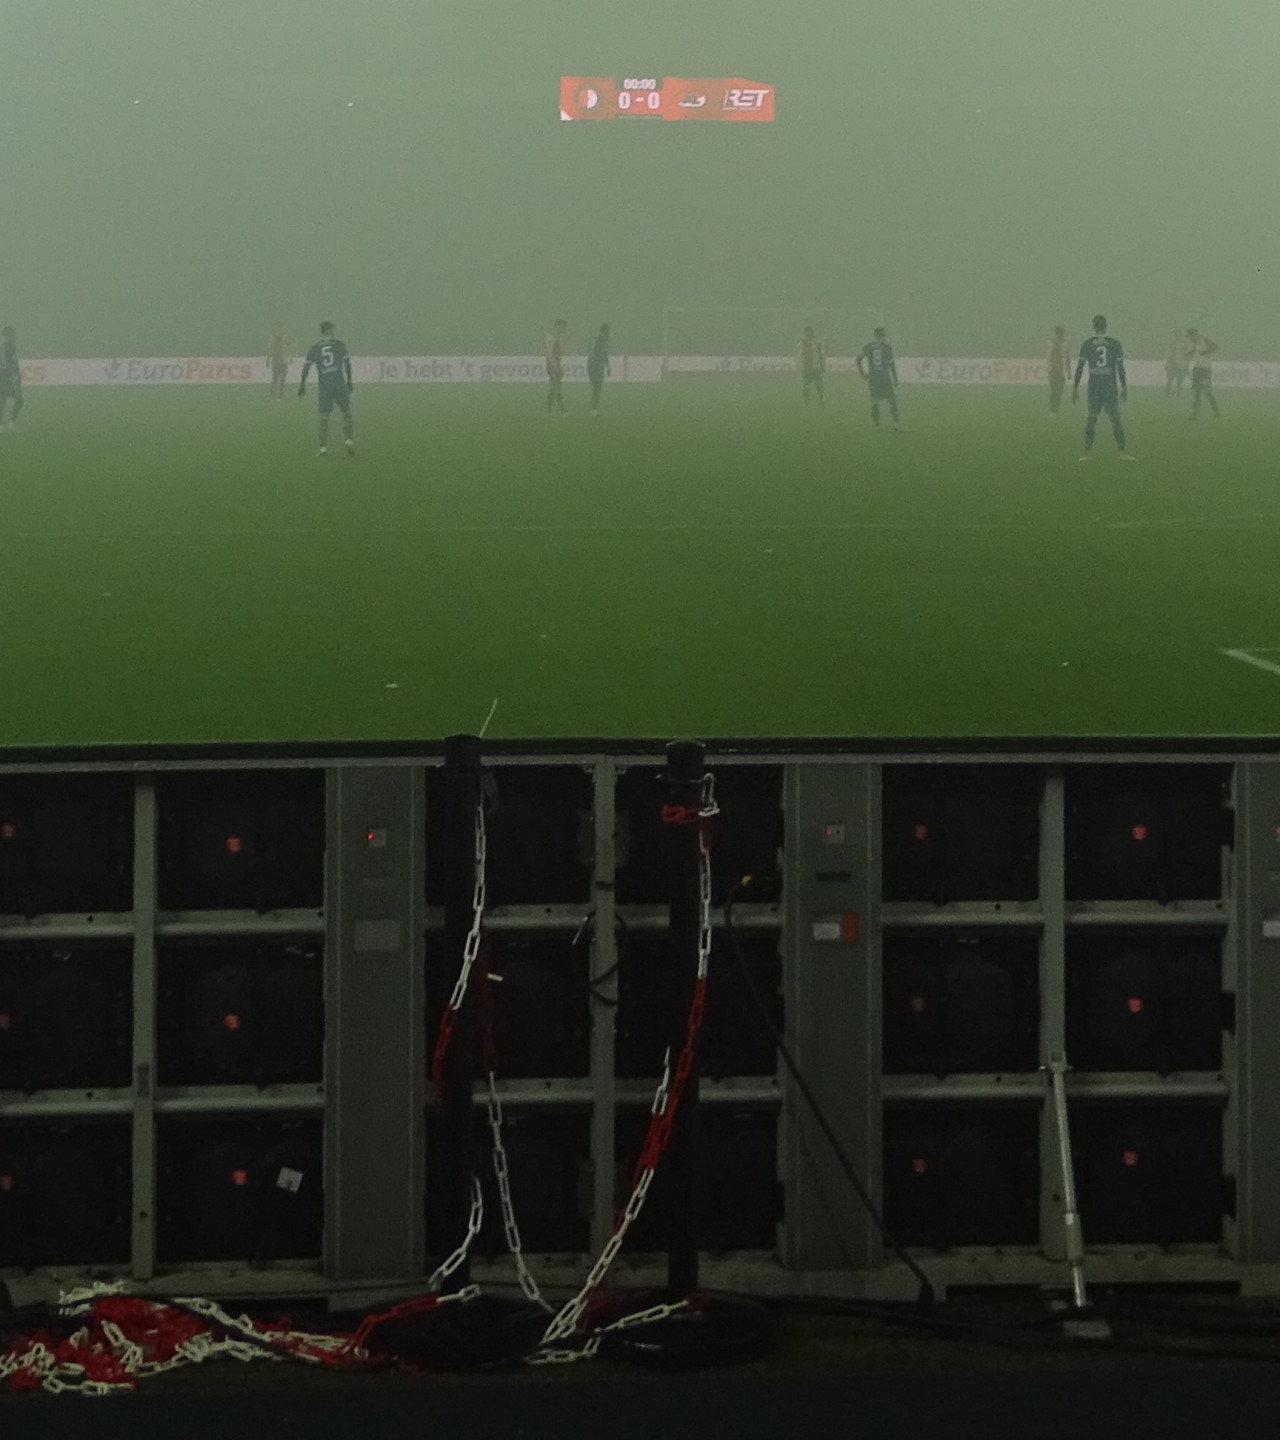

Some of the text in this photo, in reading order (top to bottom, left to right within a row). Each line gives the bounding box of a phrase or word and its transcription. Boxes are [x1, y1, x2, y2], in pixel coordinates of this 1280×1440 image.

[321, 346, 334, 367] 5
[1095, 346, 1107, 367] 3
[125, 359, 253, 381] EuroParcs
[937, 361, 1050, 381] EuroParc
